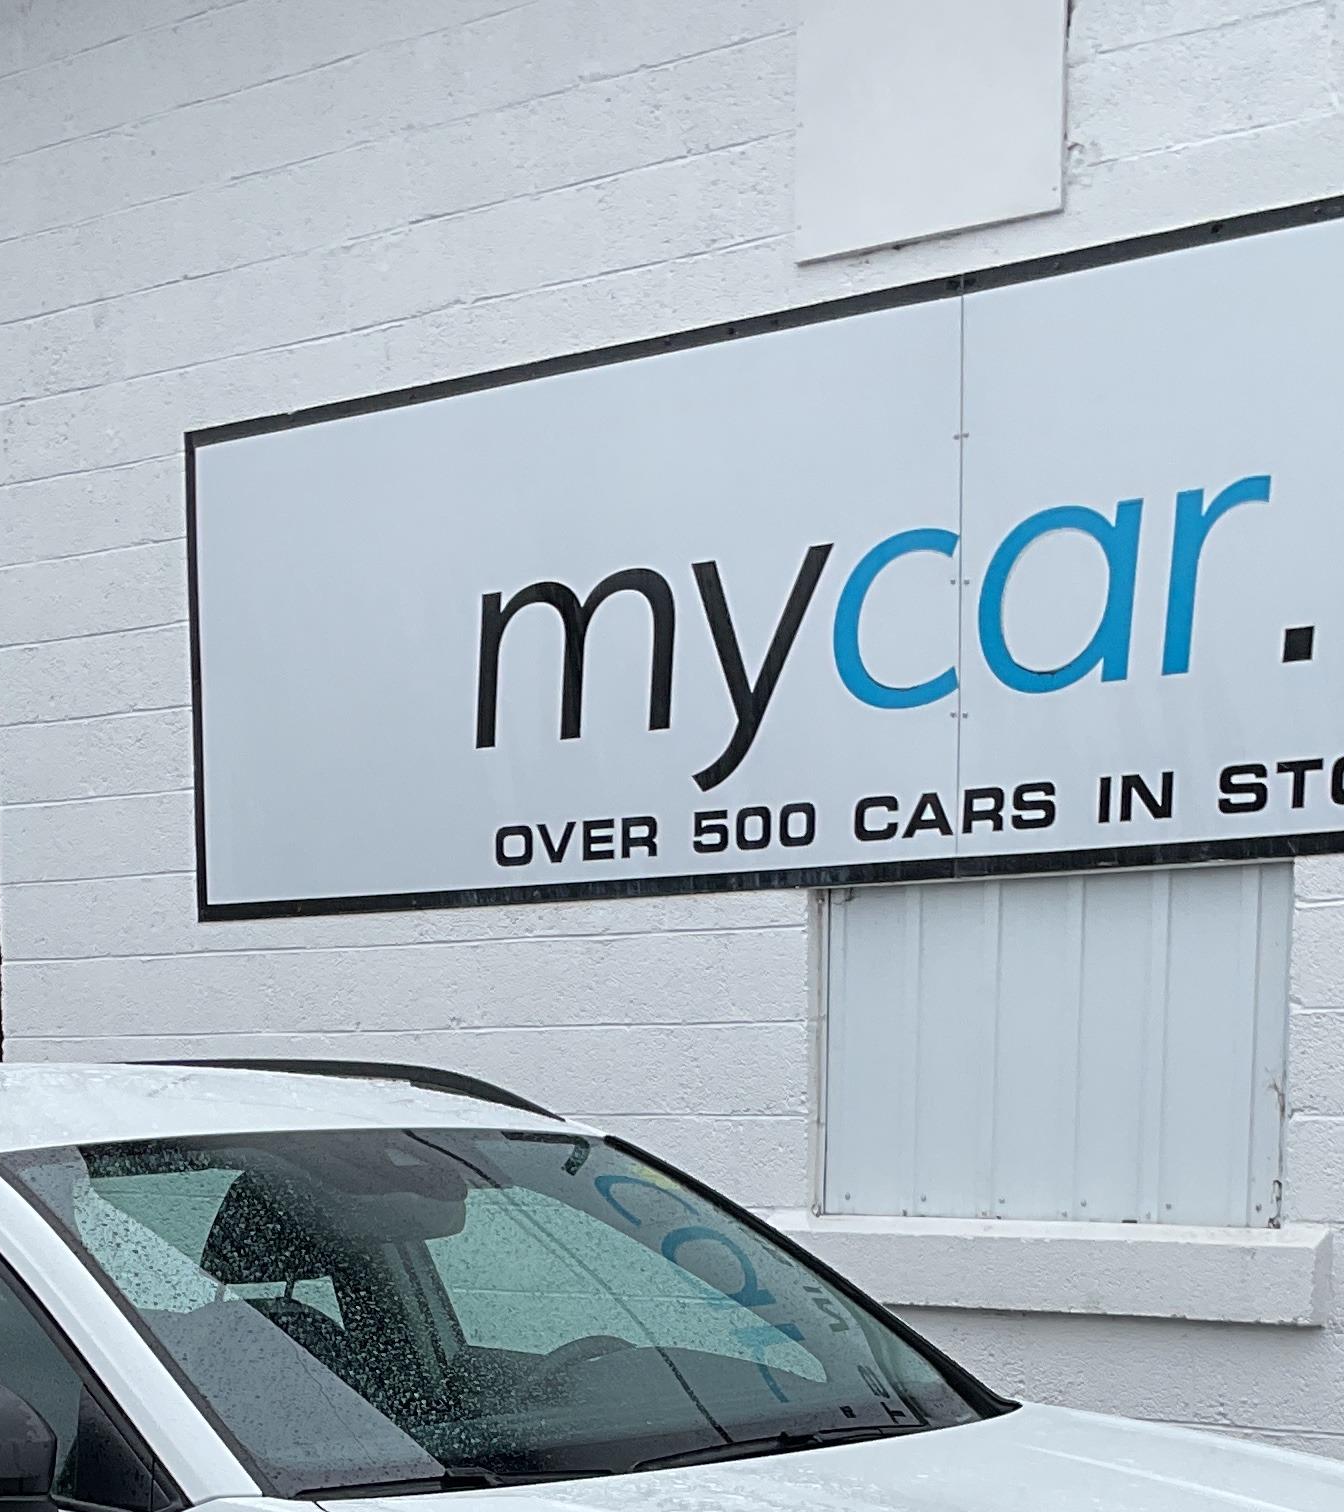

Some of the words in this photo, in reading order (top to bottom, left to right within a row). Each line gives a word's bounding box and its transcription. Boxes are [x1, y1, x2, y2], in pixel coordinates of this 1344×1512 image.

[495, 816, 658, 867] OVER
[693, 802, 816, 854] 500
[854, 781, 1056, 842] CARS
[1098, 771, 1174, 824] IN
